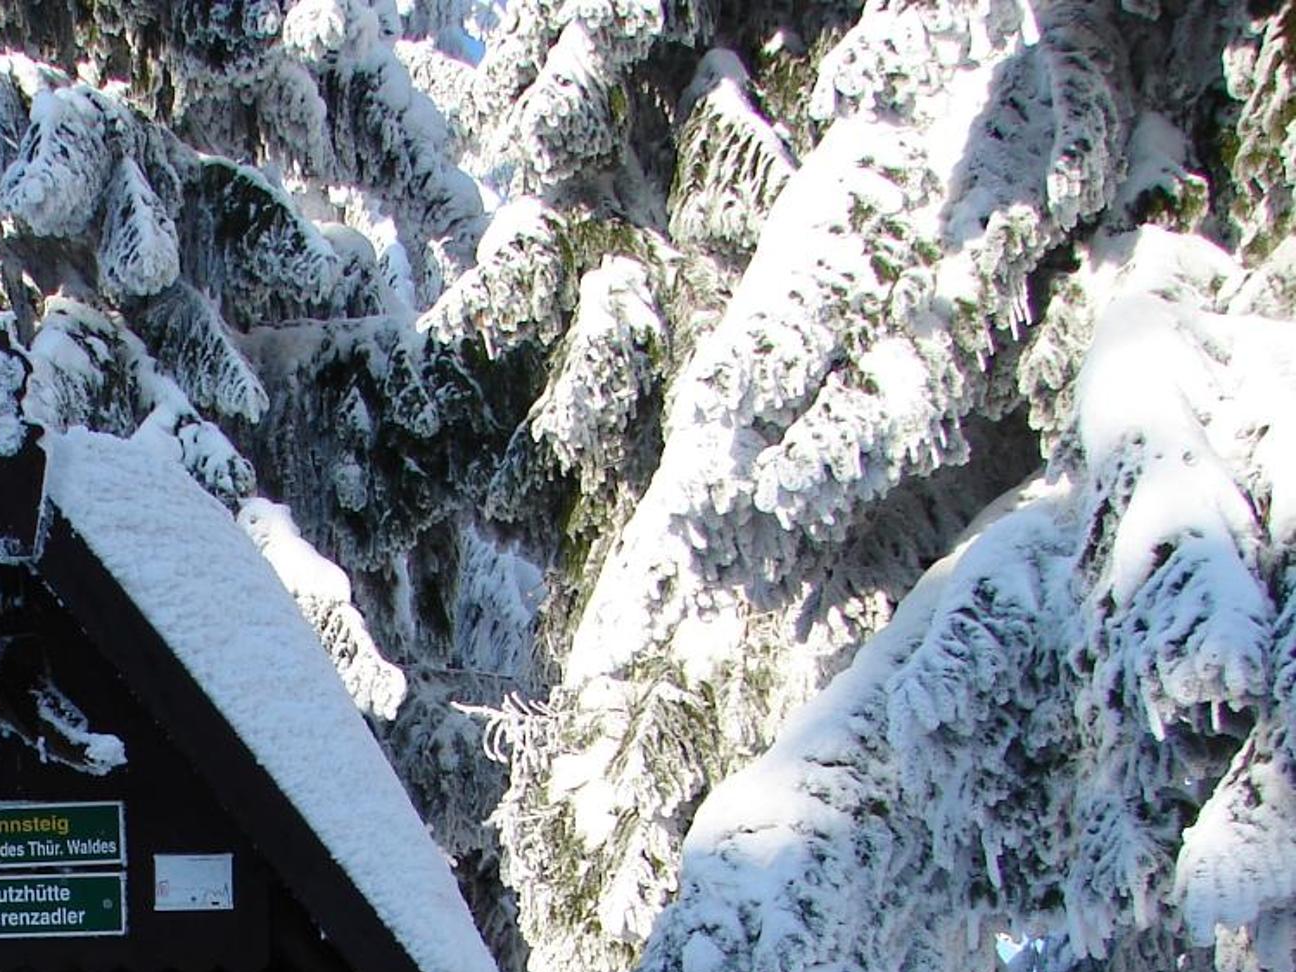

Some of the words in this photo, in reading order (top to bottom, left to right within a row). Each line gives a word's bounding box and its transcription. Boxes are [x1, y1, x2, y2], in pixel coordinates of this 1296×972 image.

[0, 841, 25, 858] des
[27, 839, 64, 856] Thür.
[66, 838, 117, 855] Waldes
